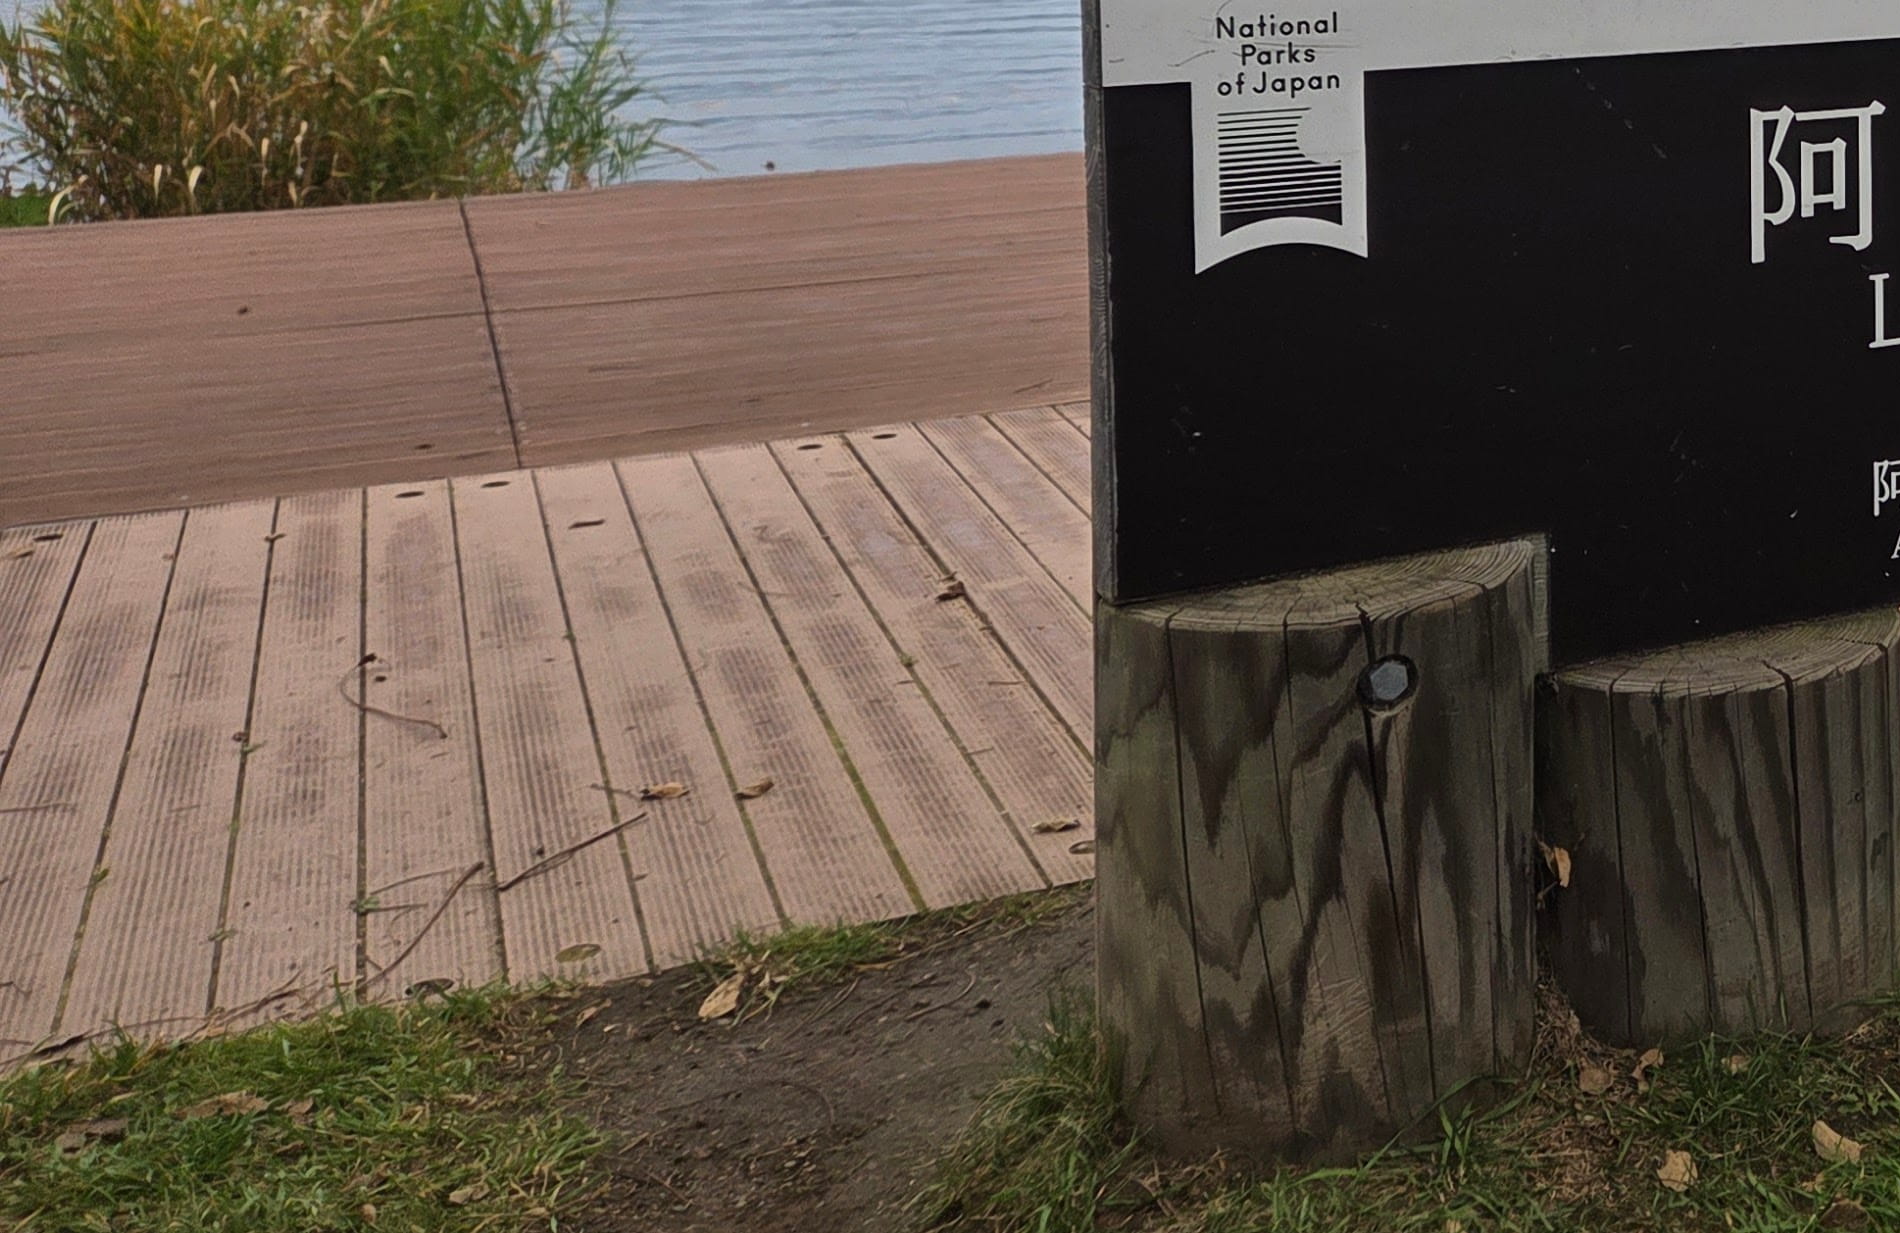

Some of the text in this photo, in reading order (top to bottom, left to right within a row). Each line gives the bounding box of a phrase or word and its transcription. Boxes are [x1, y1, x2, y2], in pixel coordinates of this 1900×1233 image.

[1215, 11, 1338, 39] National
[1240, 41, 1317, 66] Parks
[1216, 71, 1341, 99] of Japan
